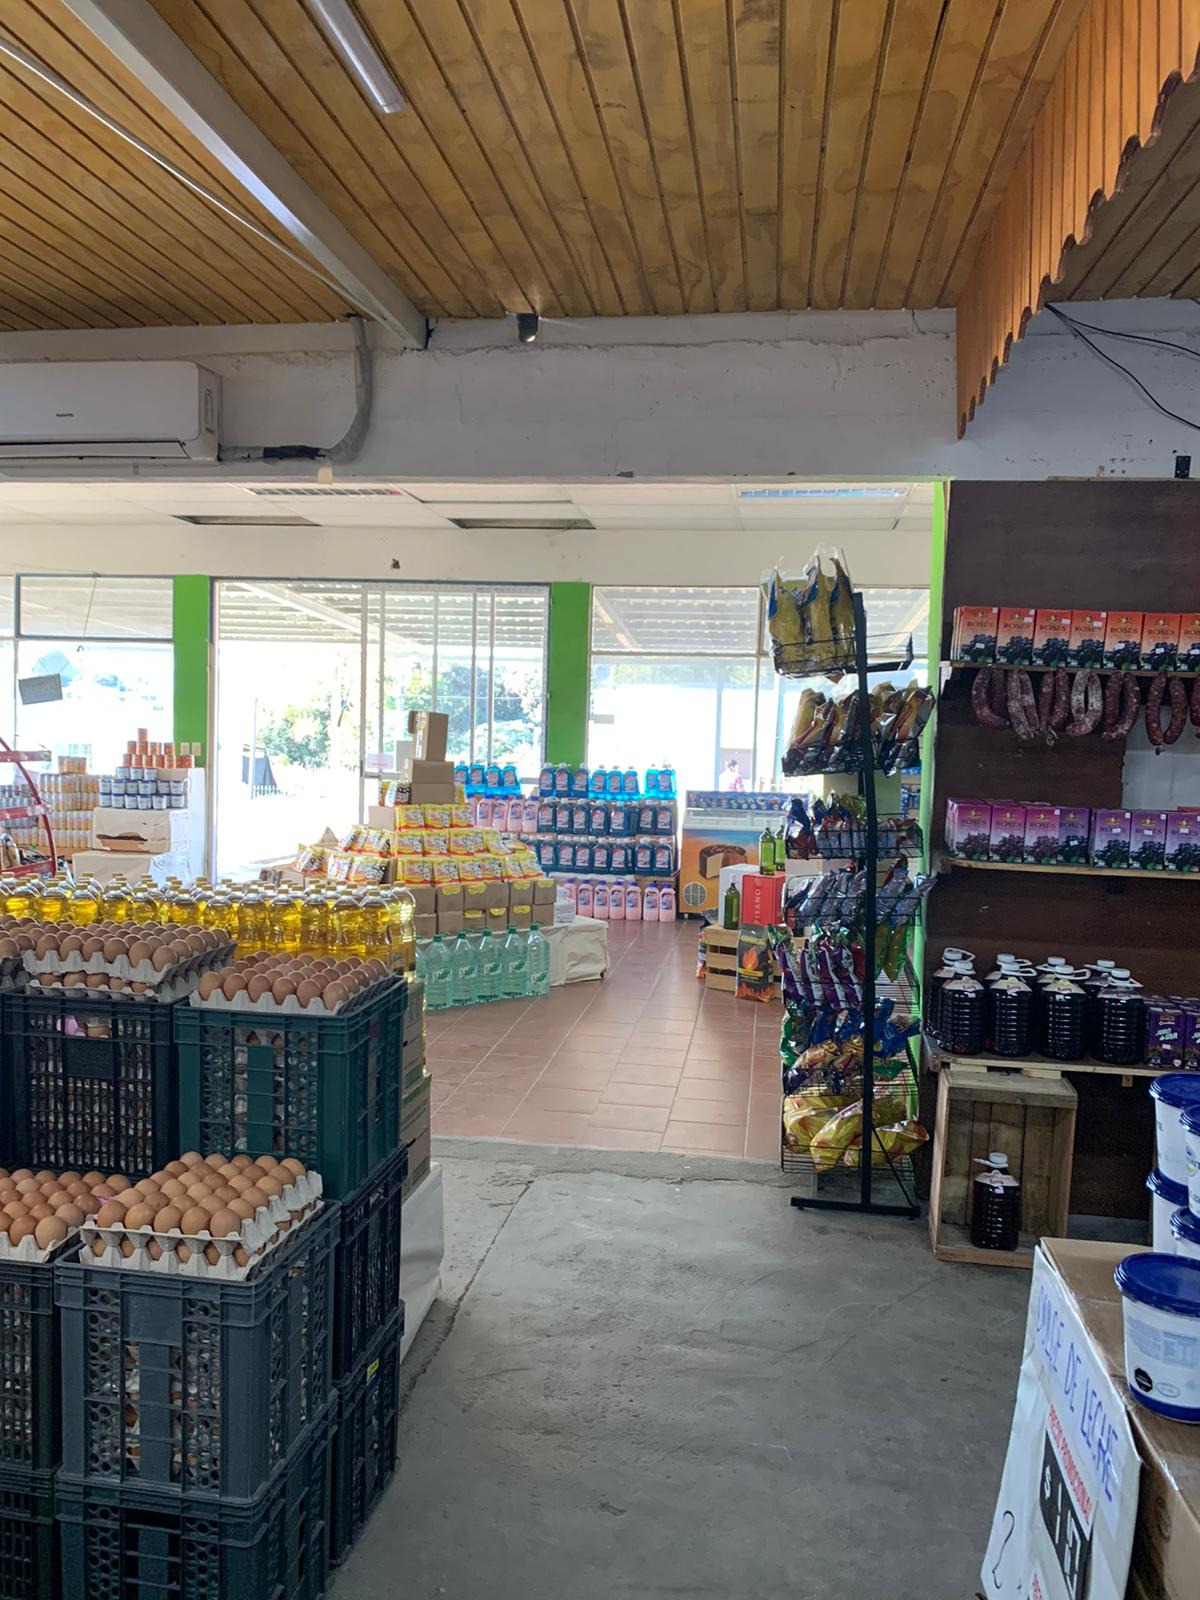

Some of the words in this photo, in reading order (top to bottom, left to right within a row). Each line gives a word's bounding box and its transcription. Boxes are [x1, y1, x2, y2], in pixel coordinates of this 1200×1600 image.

[1064, 1341, 1082, 1414] DE
[1080, 1377, 1120, 1504] LECHE
[1043, 1464, 1052, 1501] $
